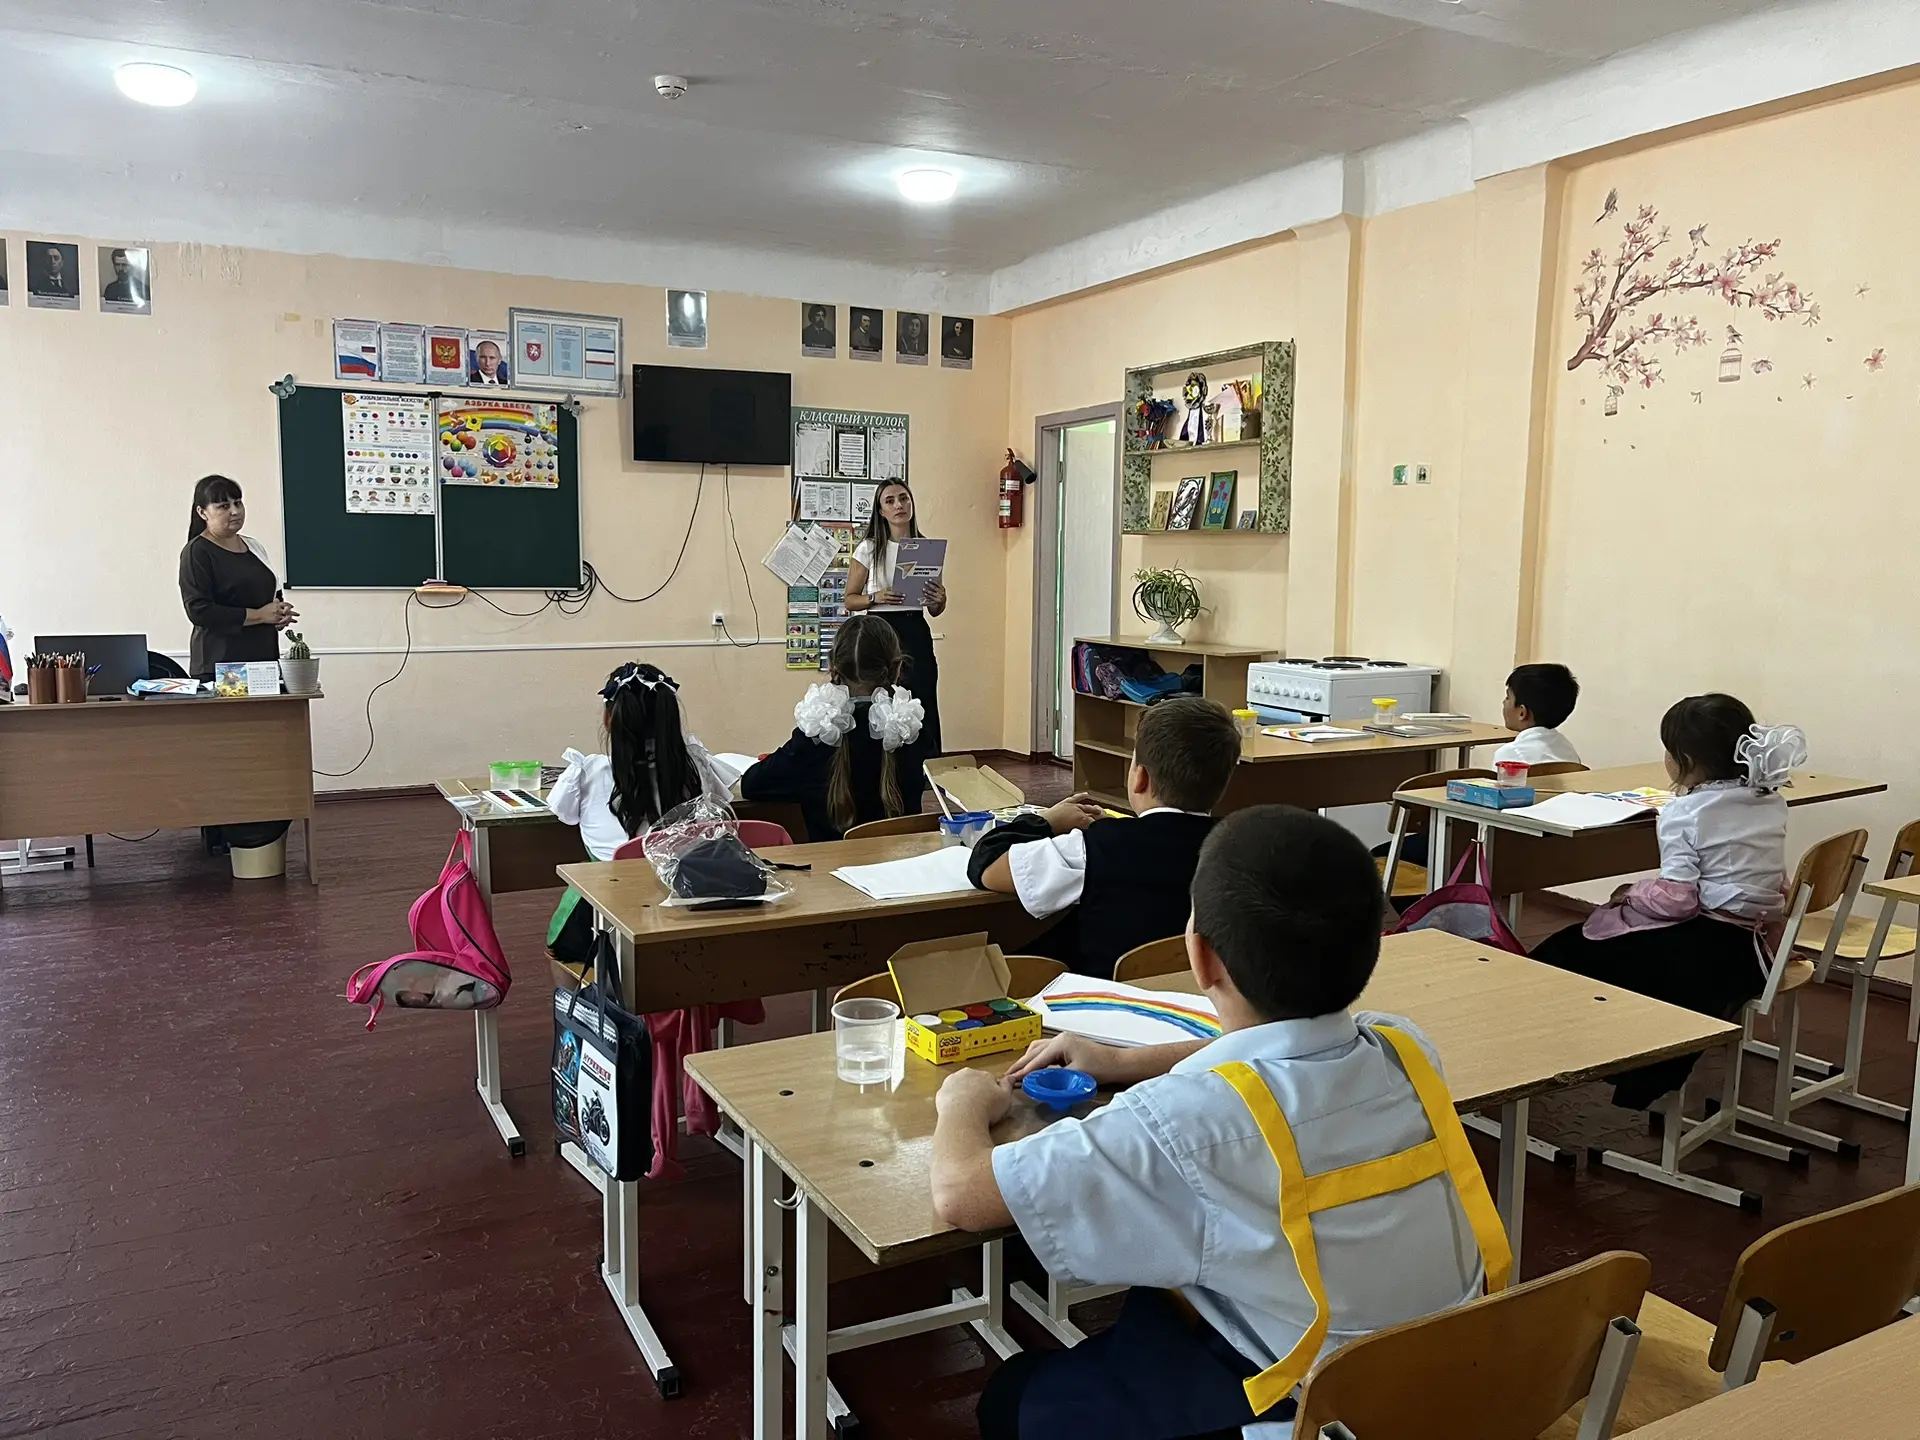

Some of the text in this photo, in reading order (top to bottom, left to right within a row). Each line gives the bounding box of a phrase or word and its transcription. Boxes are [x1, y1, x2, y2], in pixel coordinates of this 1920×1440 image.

[464, 399, 532, 410] АЗБУКА ЦВЕТА
[799, 410, 906, 427] КЛАССНЫЙ УГОЛОК
